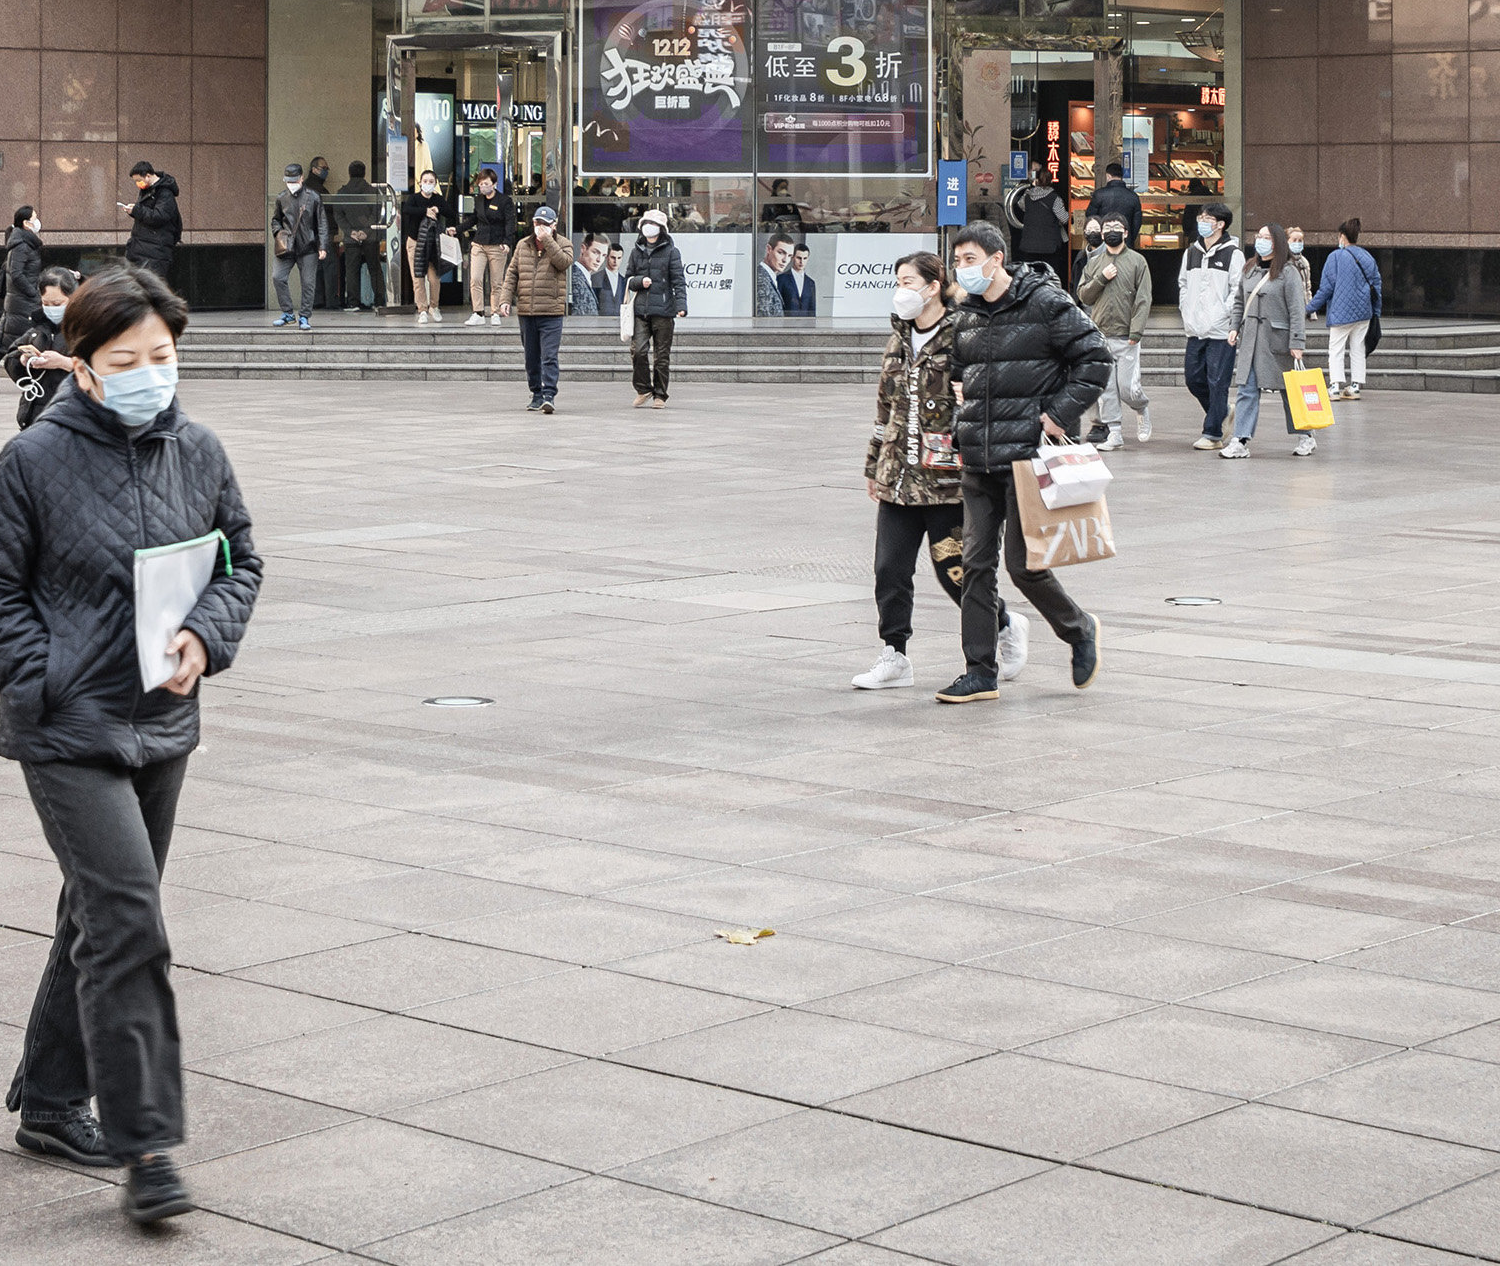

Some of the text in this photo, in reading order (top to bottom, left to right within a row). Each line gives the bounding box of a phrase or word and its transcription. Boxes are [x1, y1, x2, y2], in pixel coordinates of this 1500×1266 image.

[652, 37, 691, 56] 12.12
[765, 36, 902, 86] 低至3折
[809, 93, 825, 102] 8折
[946, 177, 960, 207] 进口
[683, 263, 724, 276] CH 海
[837, 263, 894, 275] CONCH
